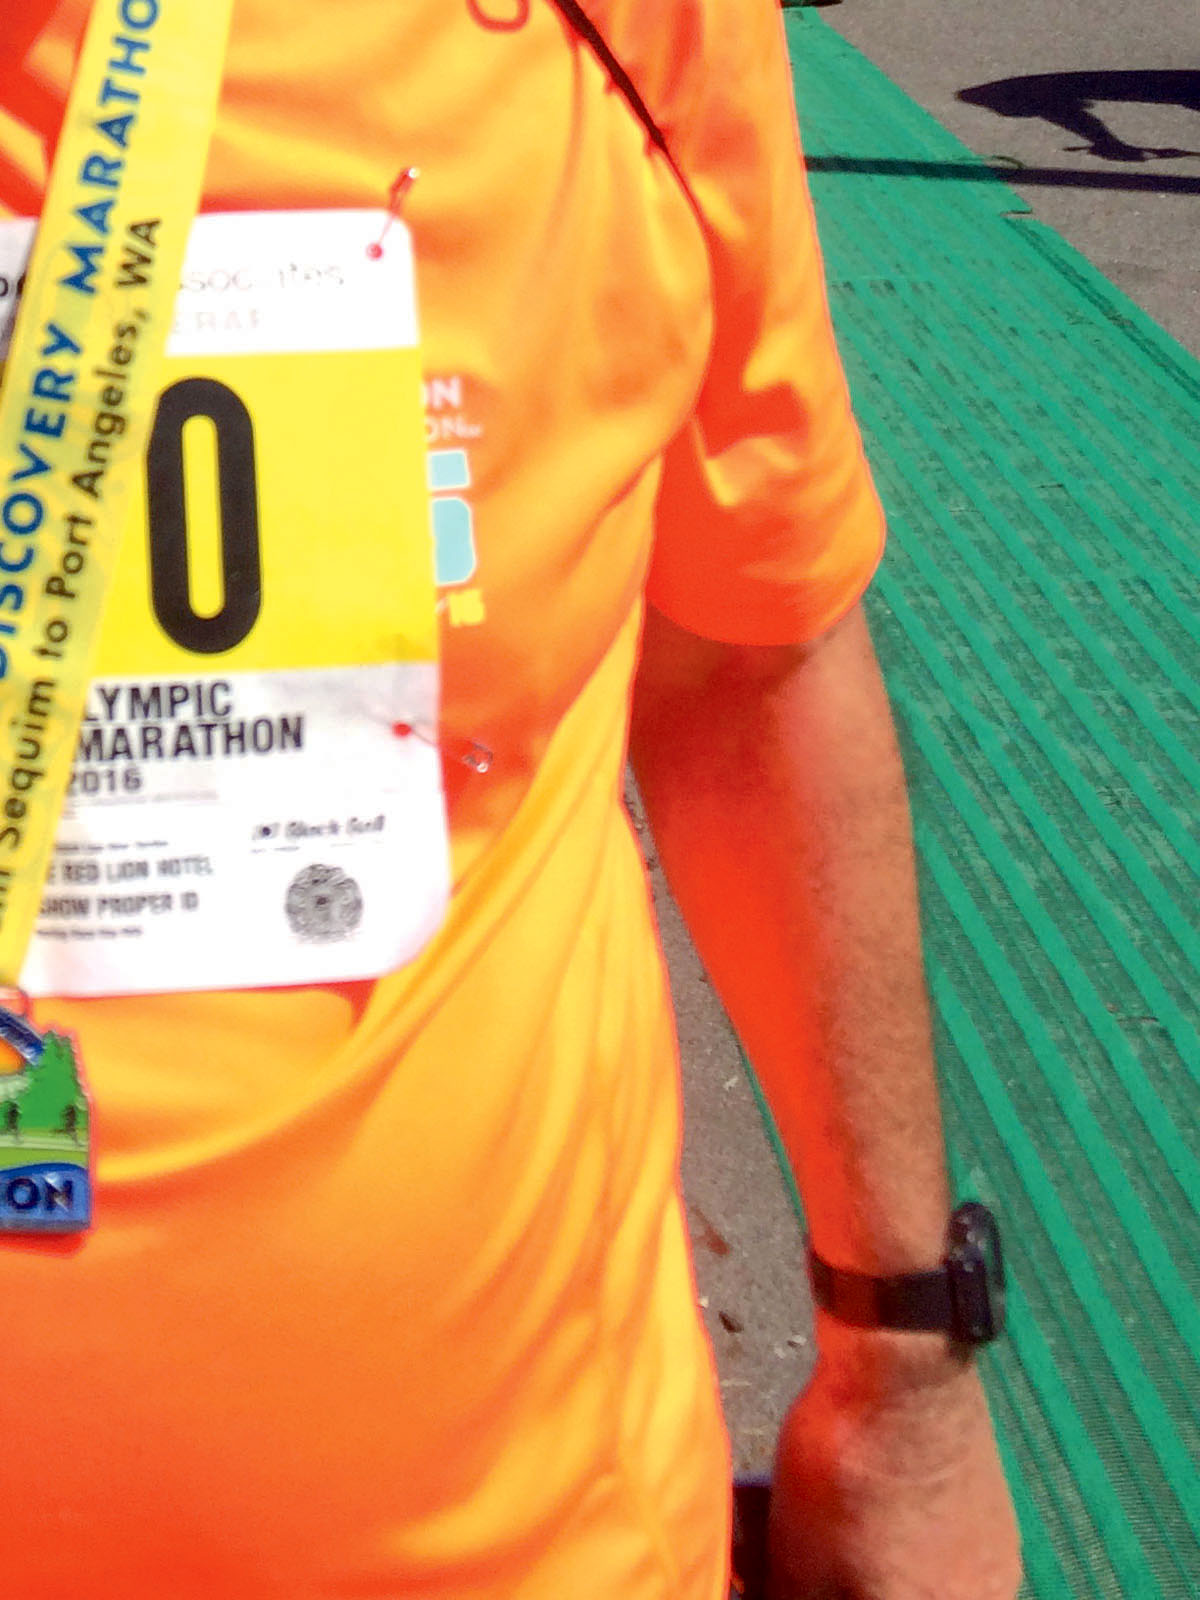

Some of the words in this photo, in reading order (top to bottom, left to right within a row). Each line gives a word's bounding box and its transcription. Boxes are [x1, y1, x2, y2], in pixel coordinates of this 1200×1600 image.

[115, 216, 162, 289] WA
[71, 309, 150, 499] Angeles,
[45, 513, 93, 600] Port
[33, 617, 69, 660] to
[78, 715, 306, 762] MARATHON
